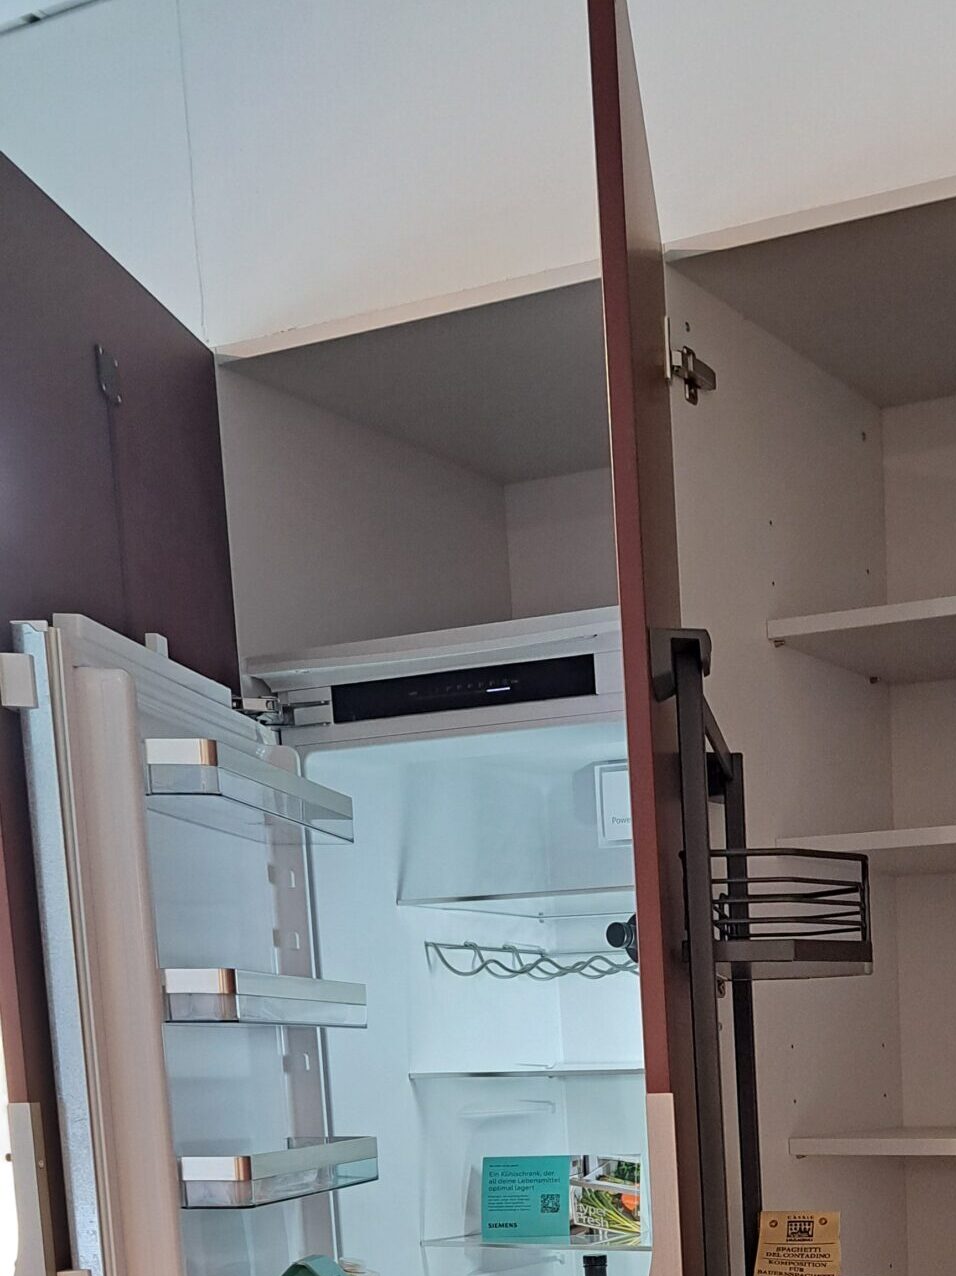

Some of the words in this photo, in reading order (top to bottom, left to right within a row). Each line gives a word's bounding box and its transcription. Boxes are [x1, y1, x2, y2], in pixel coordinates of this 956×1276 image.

[776, 1246, 822, 1254] SPAGHETTI
[783, 1251, 831, 1259] CONTADINO
[768, 1259, 827, 1268] KOMPOSITION
